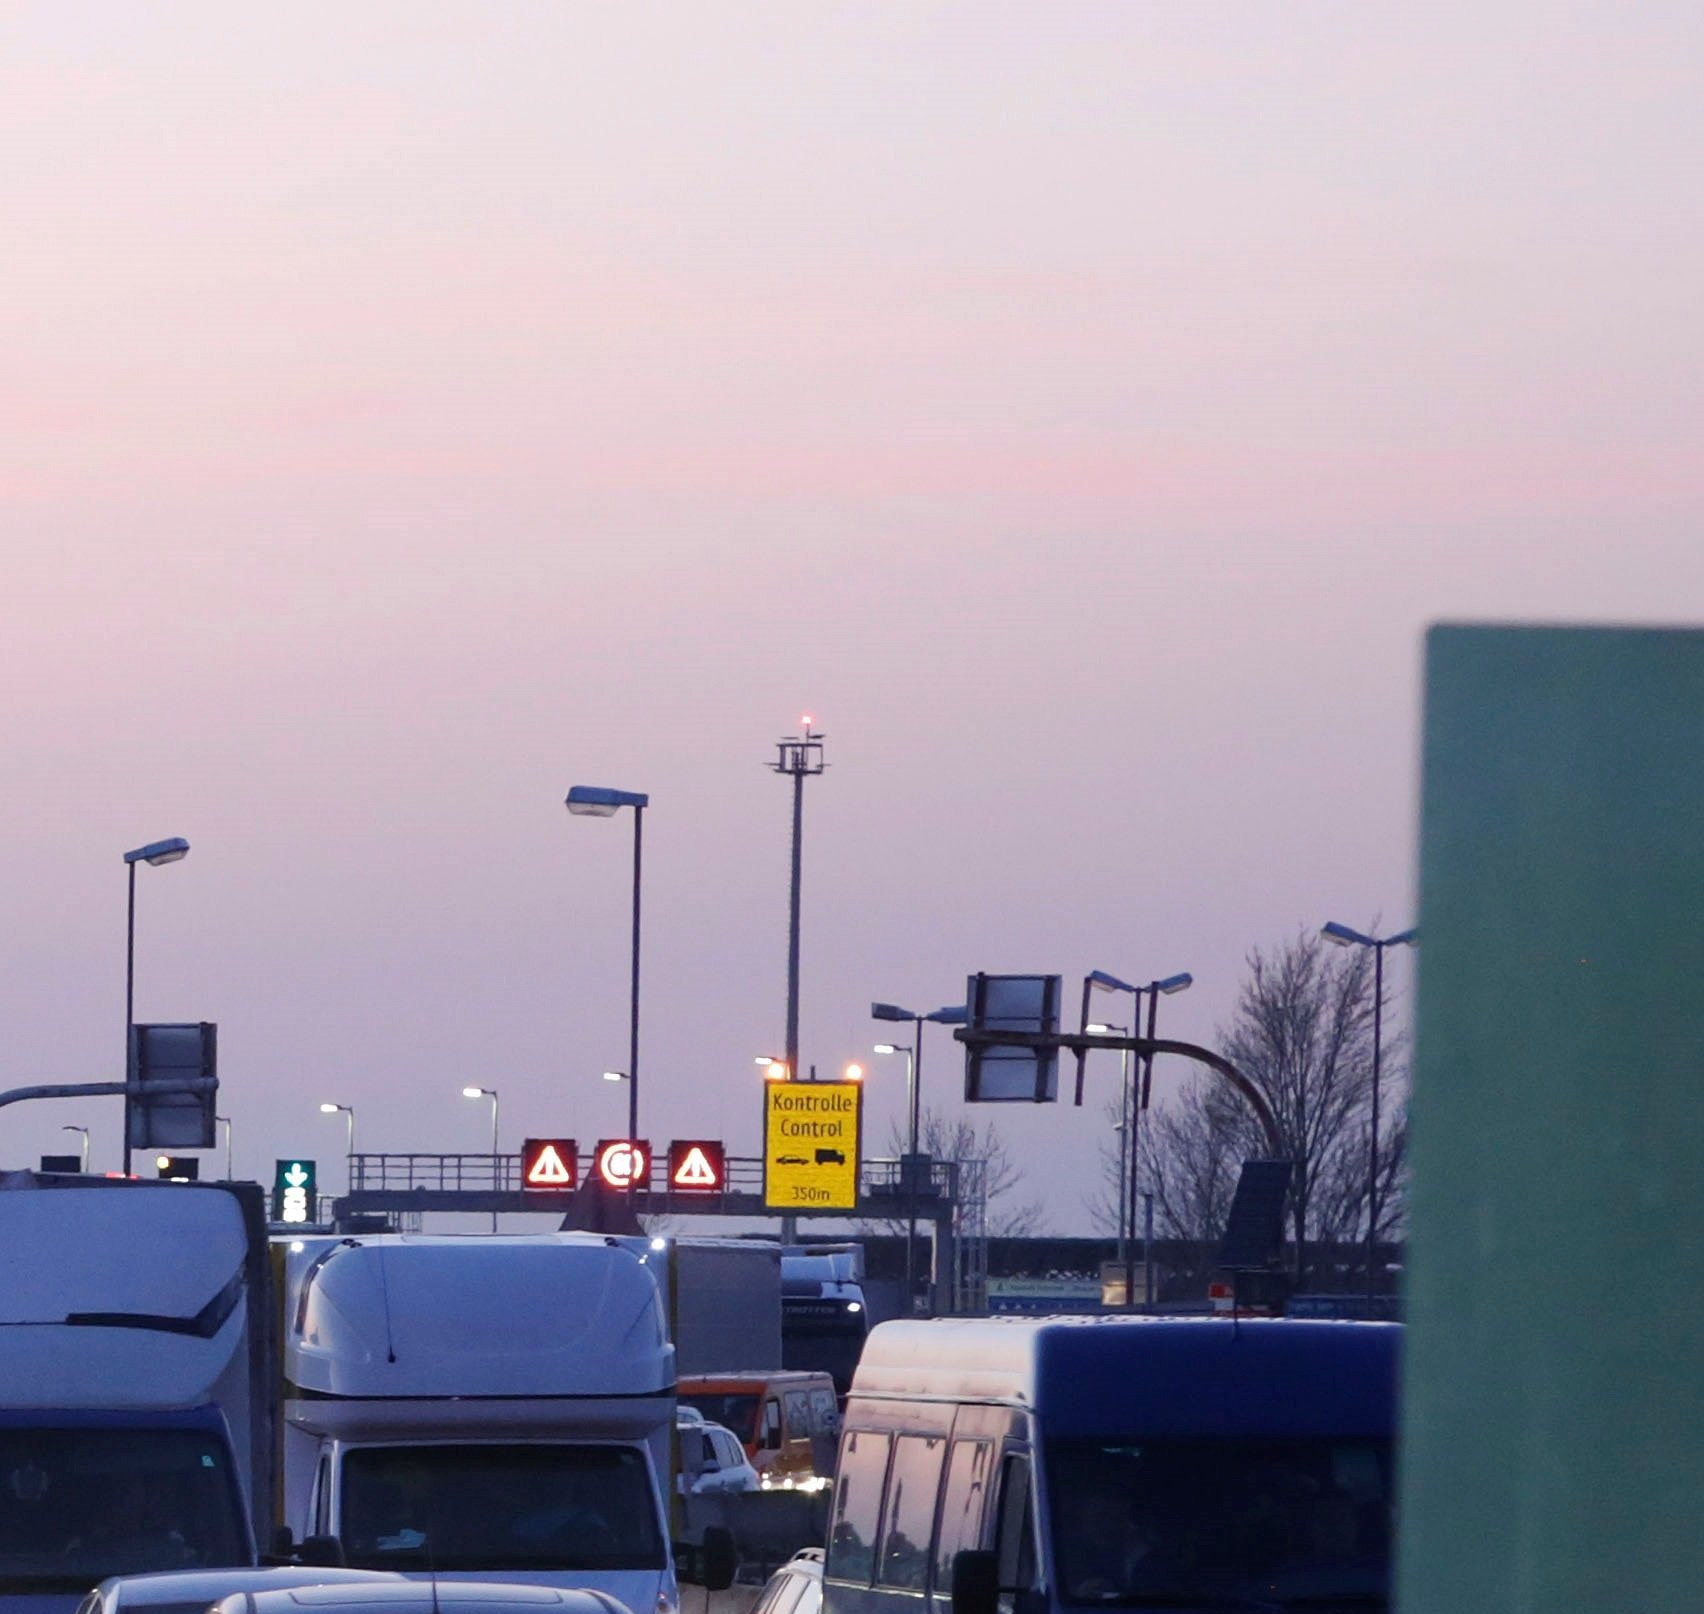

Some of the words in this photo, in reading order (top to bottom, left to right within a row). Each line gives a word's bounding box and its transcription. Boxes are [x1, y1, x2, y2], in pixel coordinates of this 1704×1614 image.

[773, 1093, 852, 1112] Kontrolle
[780, 1118, 843, 1137] Control
[791, 1186, 831, 1201] 350m
